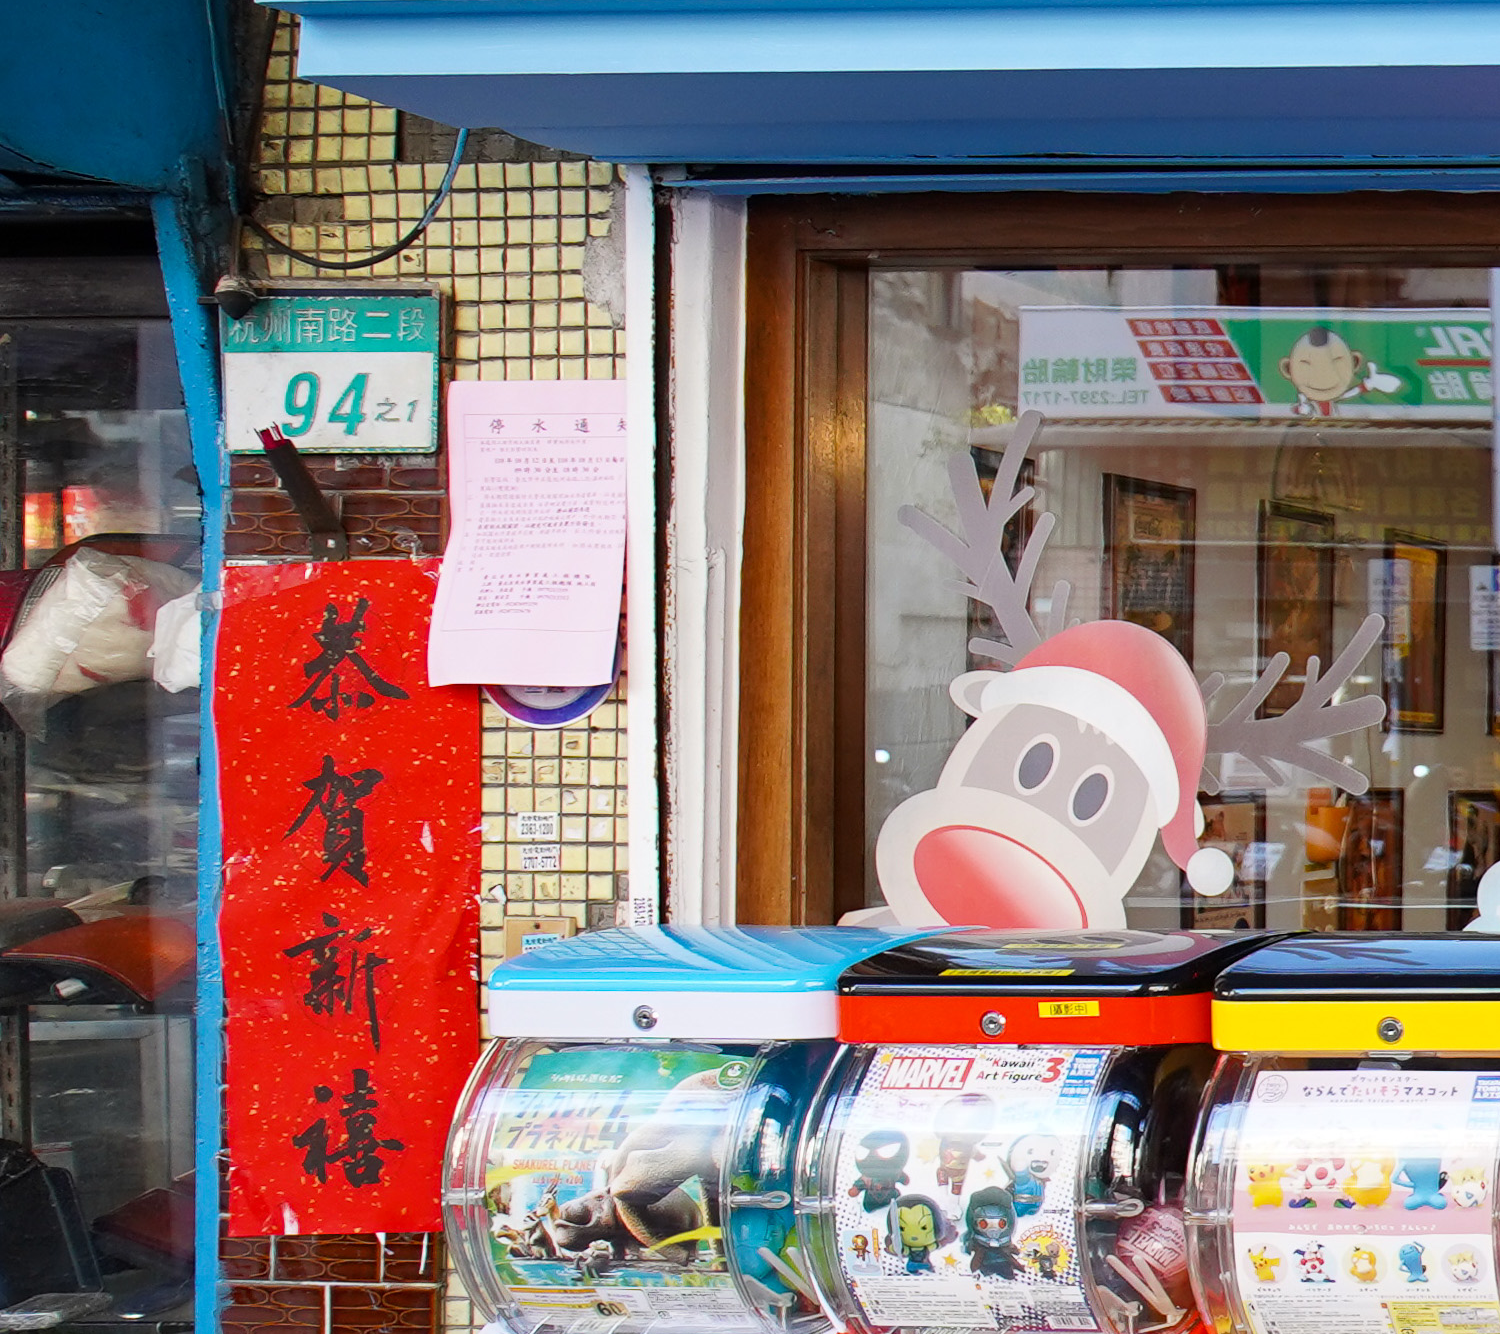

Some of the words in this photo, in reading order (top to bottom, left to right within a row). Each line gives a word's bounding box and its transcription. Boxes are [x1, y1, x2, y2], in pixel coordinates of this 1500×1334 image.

[228, 307, 427, 345] 杭州南路二段
[282, 598, 410, 1189] 恭賀新禧
[881, 1057, 976, 1090] MARVEL
[976, 1069, 999, 1082] Art
[1001, 1069, 1043, 1084] Figure
